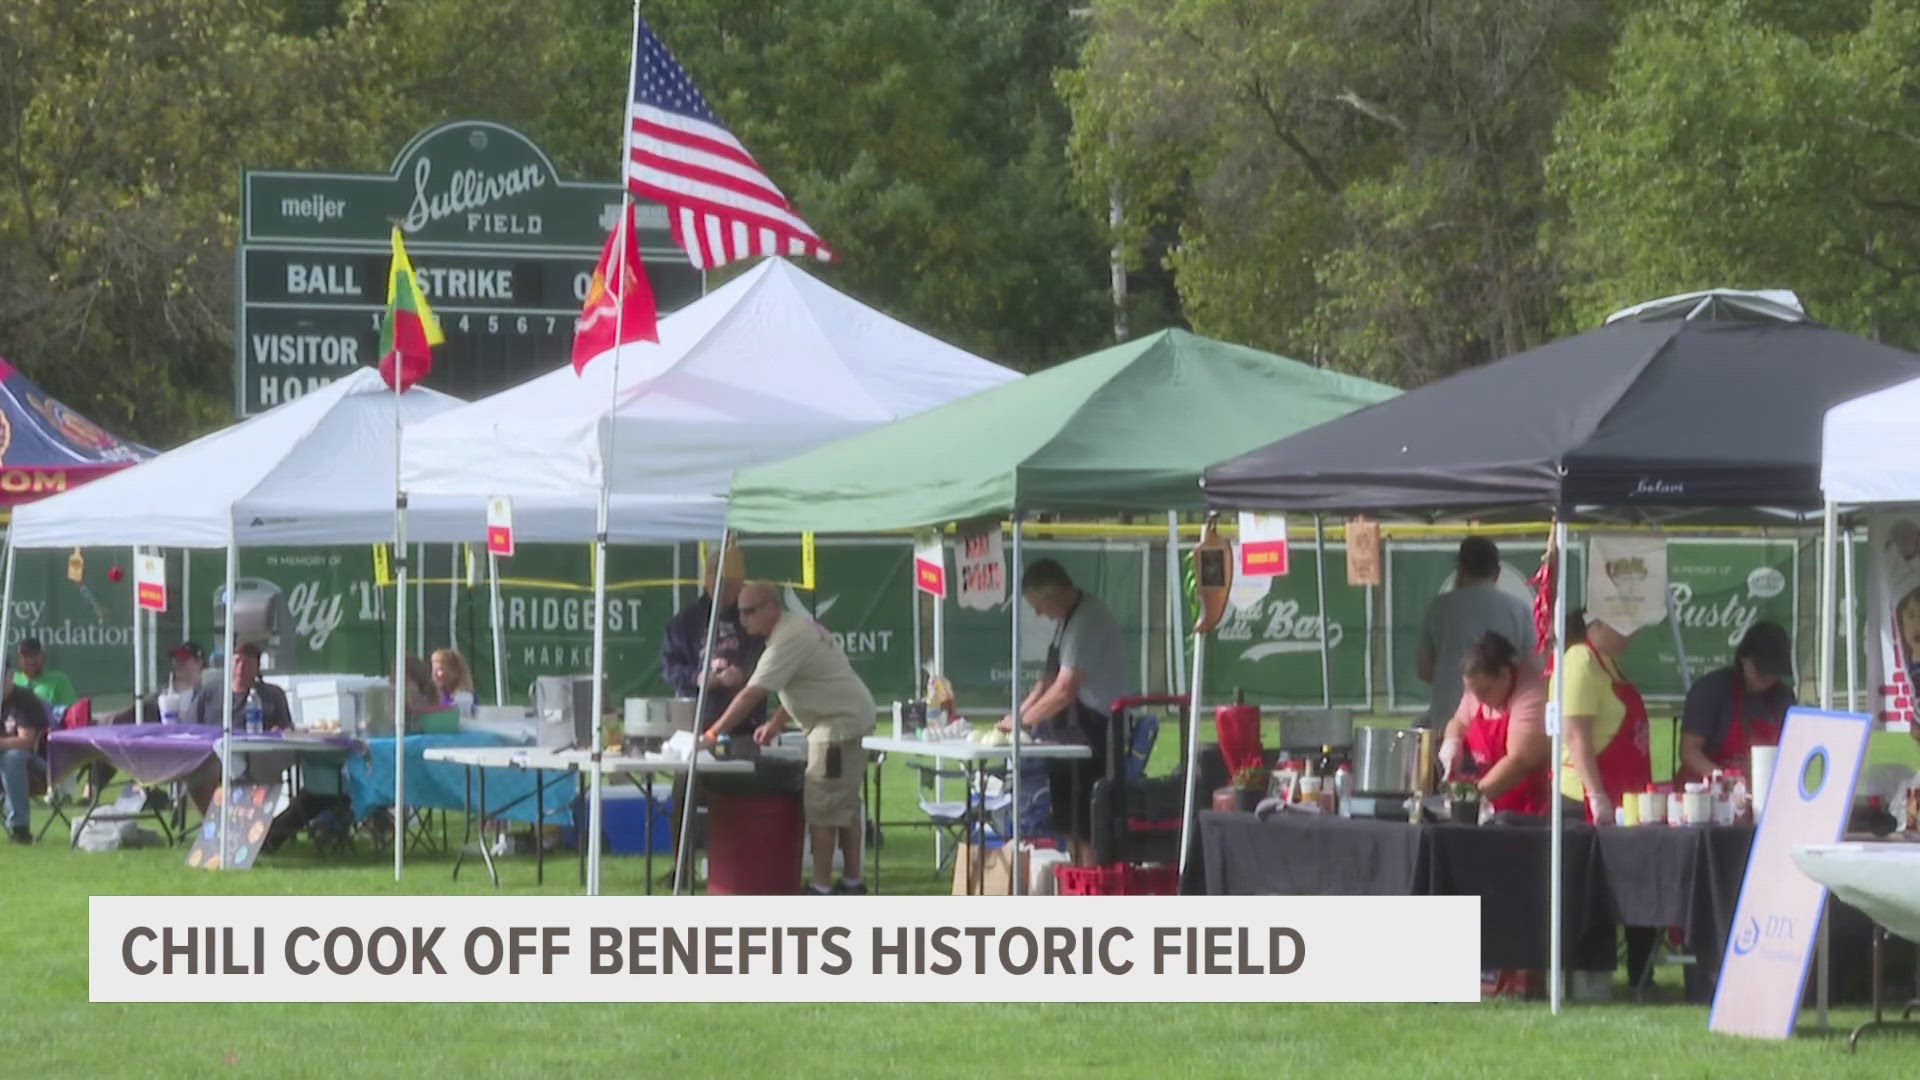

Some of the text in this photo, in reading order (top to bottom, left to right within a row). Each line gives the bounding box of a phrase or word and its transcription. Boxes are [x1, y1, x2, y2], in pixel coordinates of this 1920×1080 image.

[281, 193, 346, 222] meijer
[402, 157, 545, 232] Sullivan
[467, 213, 543, 234] FIELD
[286, 264, 362, 295] BALL
[415, 268, 513, 299] STRIKE
[458, 315, 470, 333] 4
[488, 316, 500, 333] 5
[516, 317, 528, 334] 6
[545, 317, 556, 335] 7
[252, 334, 359, 367] VISITOR
[0, 469, 67, 492] OM
[9, 600, 46, 626] rey
[1668, 582, 1758, 647] Rusty
[6, 618, 136, 646] oundation
[831, 630, 894, 653] DENT
[523, 646, 605, 667] MARKE
